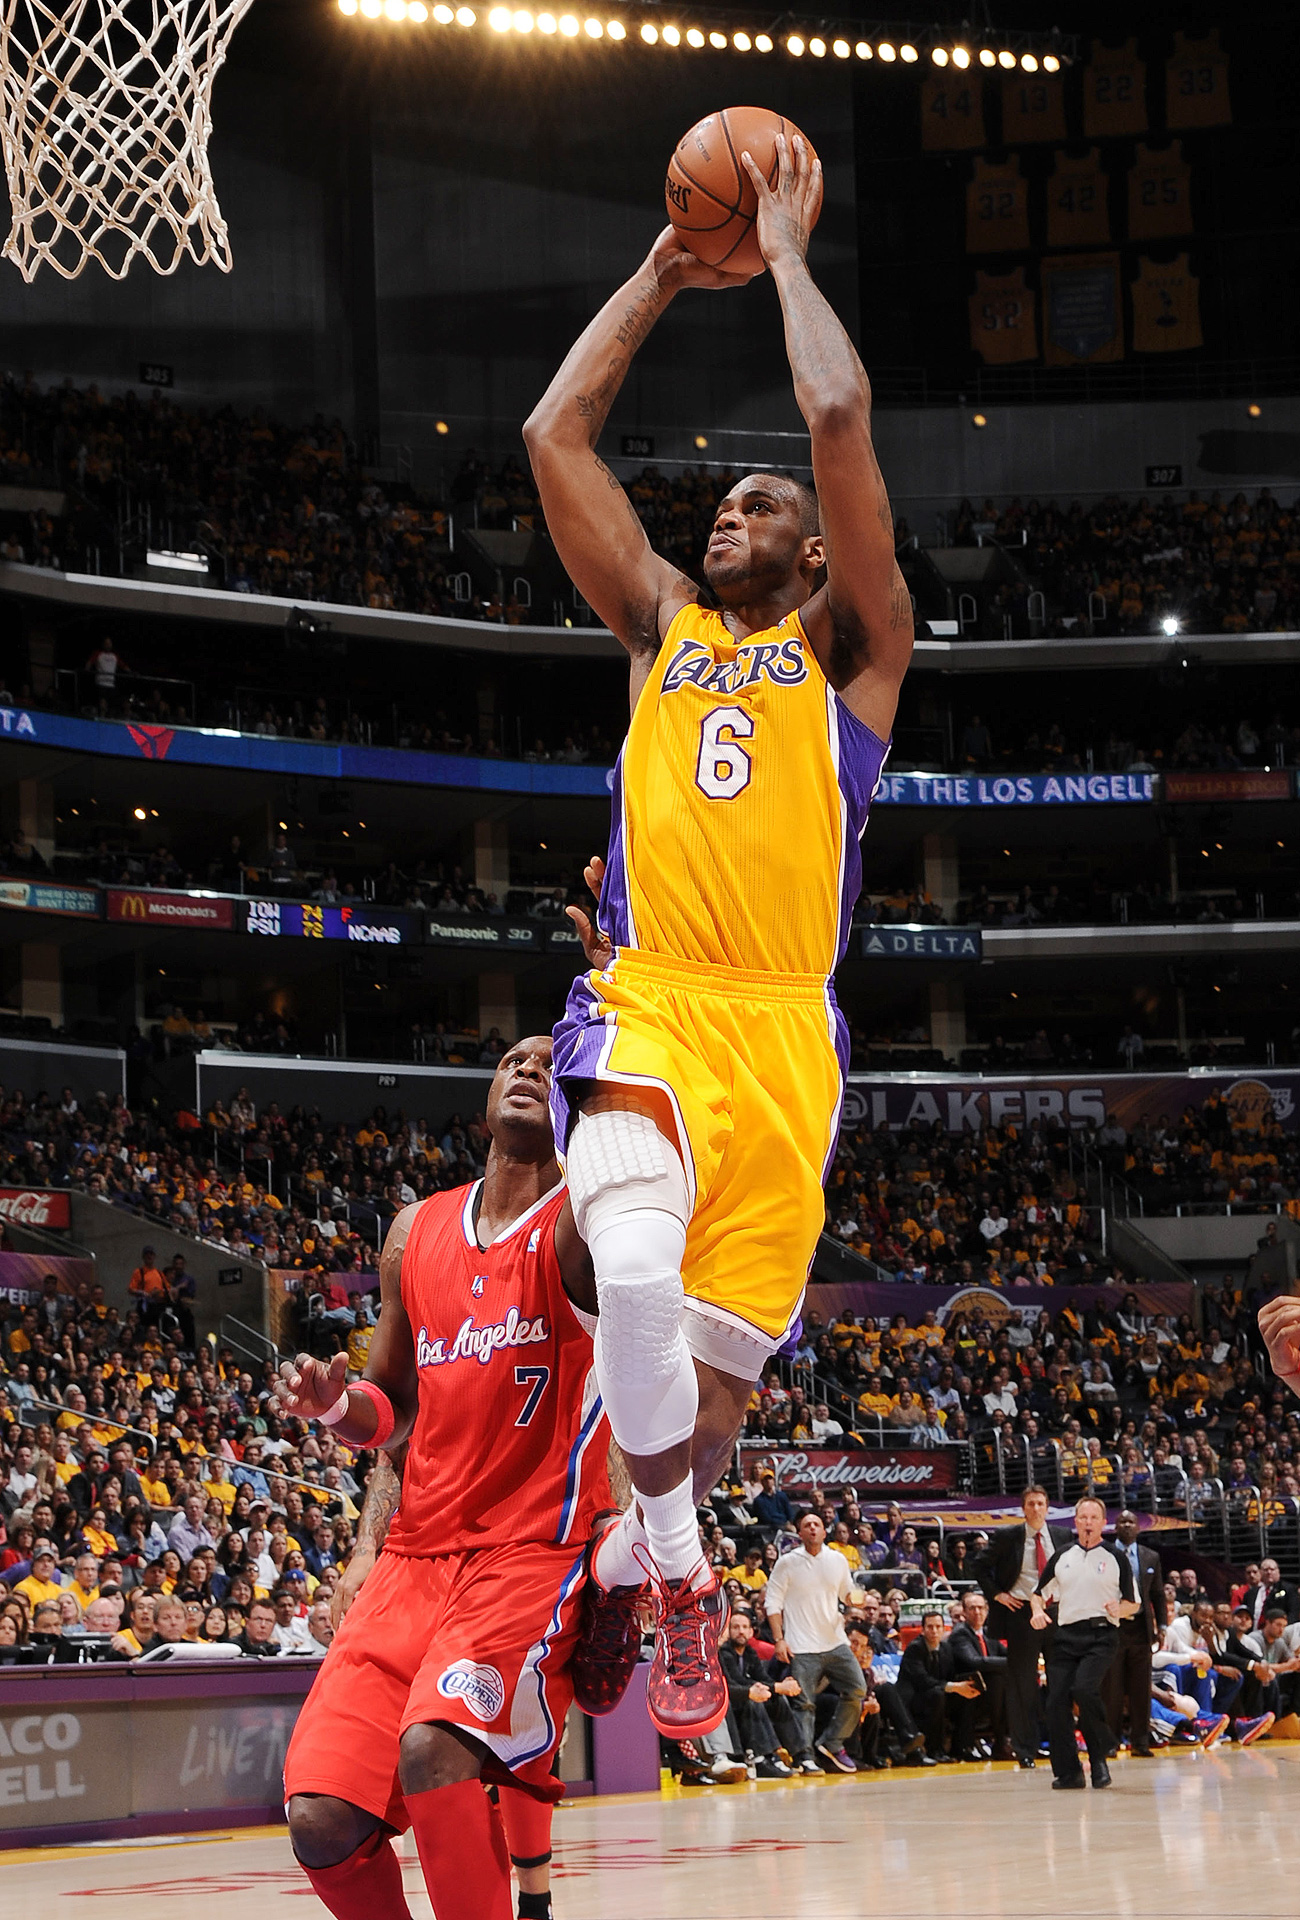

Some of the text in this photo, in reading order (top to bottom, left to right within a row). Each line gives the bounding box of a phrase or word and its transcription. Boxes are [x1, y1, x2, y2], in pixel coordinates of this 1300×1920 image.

[1096, 75, 1134, 103] 22
[1179, 68, 1214, 96] 33
[929, 89, 970, 118] 44
[1058, 185, 1096, 212] 42
[1142, 178, 1179, 206] 25
[979, 193, 1015, 220] 32
[982, 302, 1023, 331] 52
[1151, 469, 1176, 483] 307
[660, 638, 808, 697] LAKERS
[695, 705, 755, 800] 6
[874, 777, 906, 802] OF
[912, 777, 970, 804] THE
[978, 777, 1034, 803] LOS
[1168, 780, 1225, 794] WELLS
[149, 903, 218, 918] McDonald's
[341, 907, 354, 923] F
[247, 917, 281, 936] PSU
[430, 922, 533, 940] Panasonic 3D
[551, 931, 583, 942] BU
[893, 935, 976, 954] DELTA
[417, 1305, 550, 1369] Los Angeles
[514, 1365, 550, 1427] 7
[766, 1453, 933, 1486] Budweiser
[442, 1670, 498, 1713] CLIPPERS
